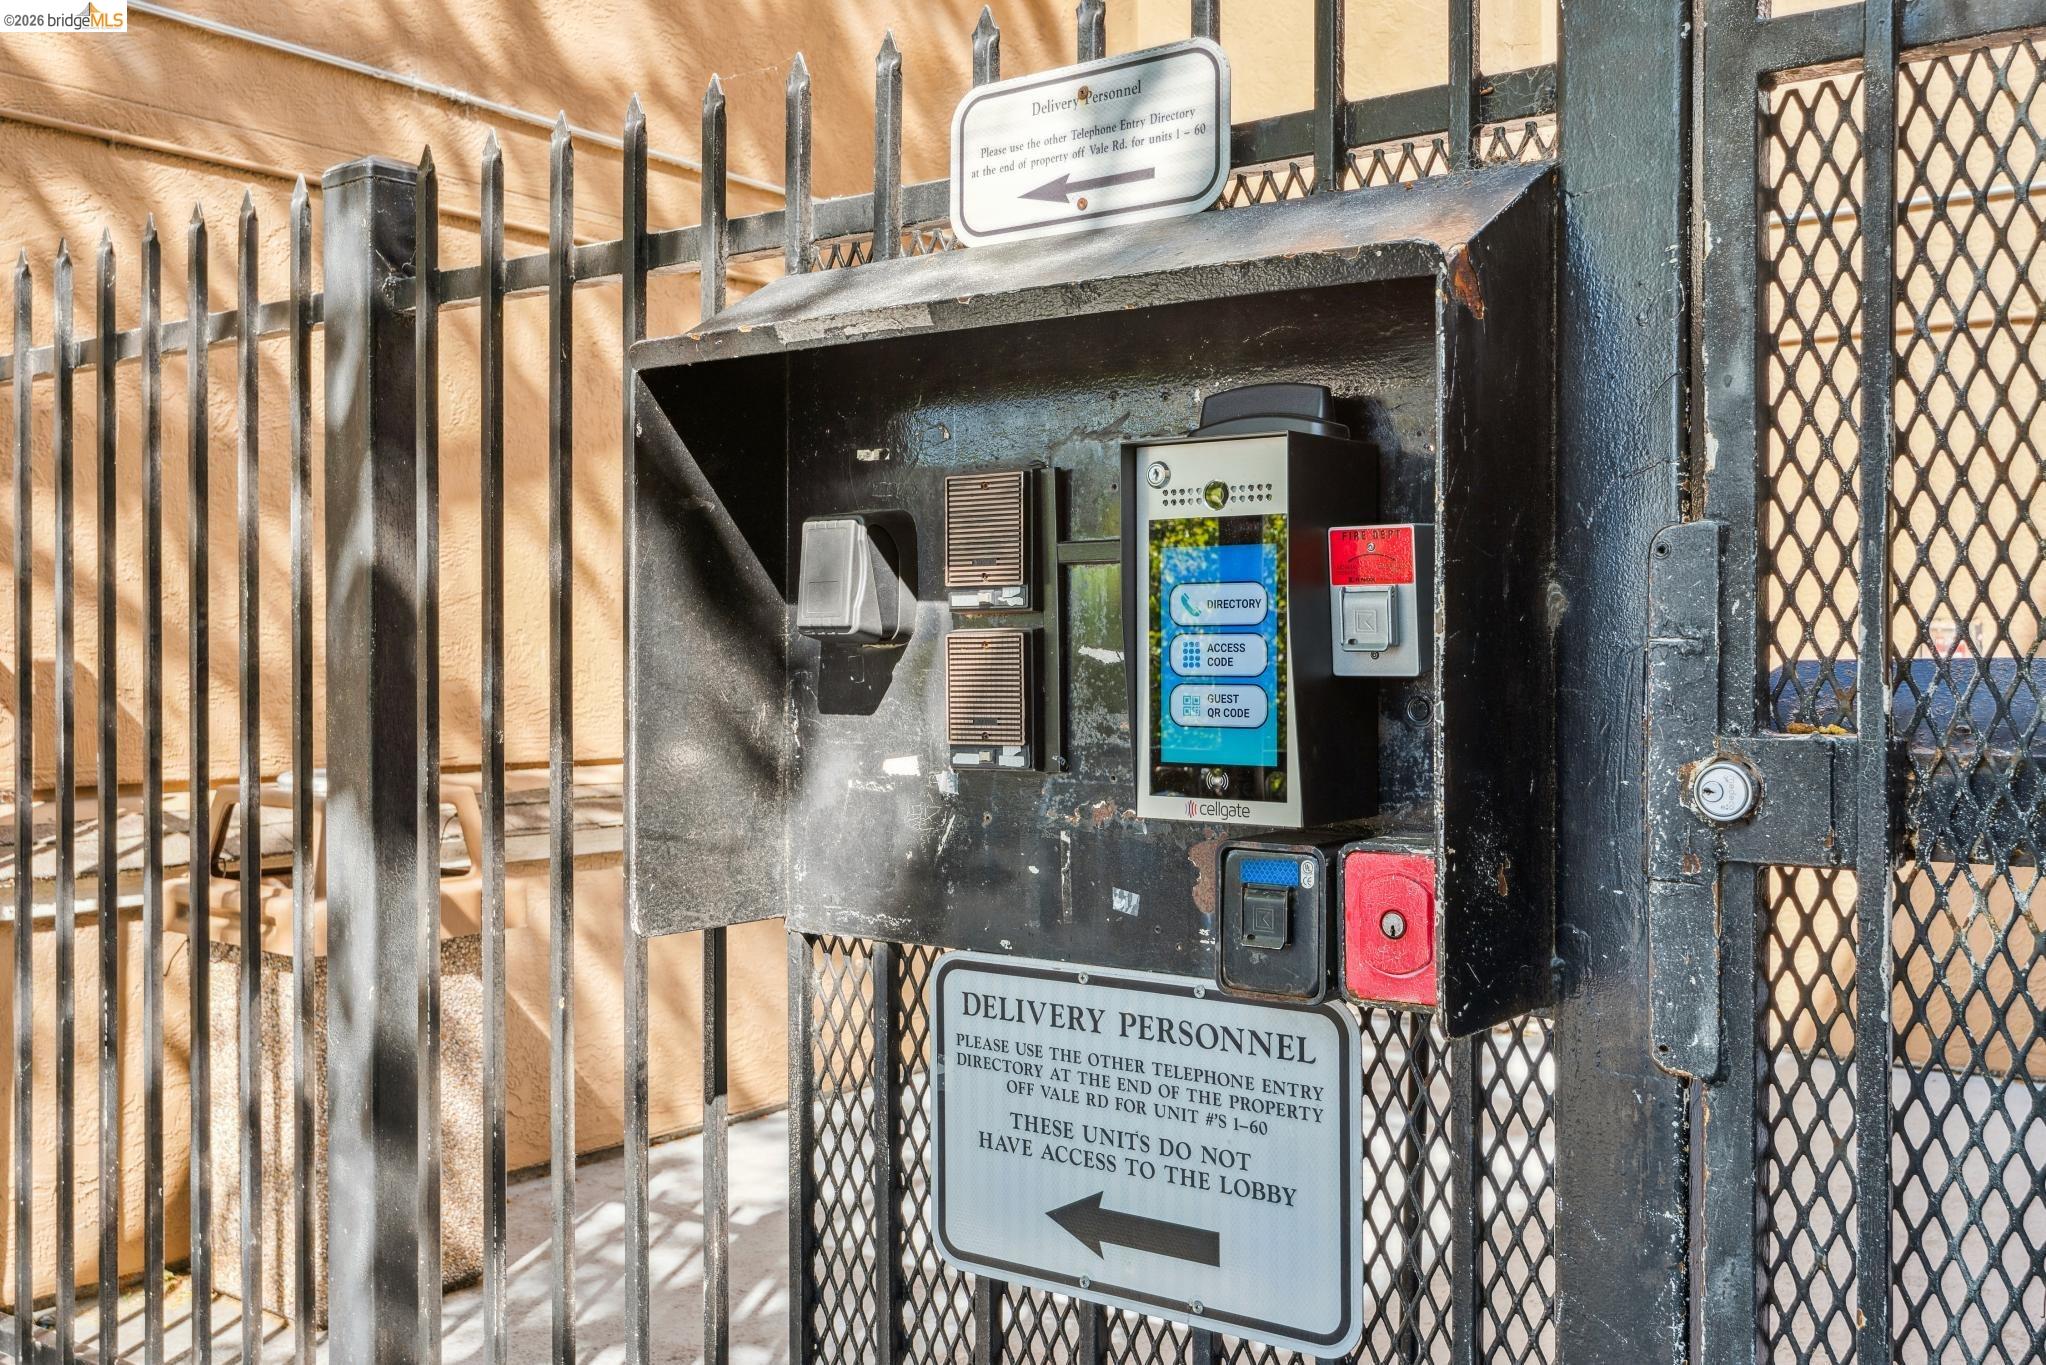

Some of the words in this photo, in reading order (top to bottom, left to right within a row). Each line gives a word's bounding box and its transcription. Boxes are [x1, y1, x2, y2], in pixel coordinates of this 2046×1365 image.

[1032, 98, 1079, 116] Delivery
[1085, 80, 1142, 105] Personnel
[971, 169, 980, 179] at
[982, 165, 996, 176] the
[999, 160, 1015, 173] end
[1018, 158, 1027, 169] of
[1030, 152, 1069, 170] property
[1072, 146, 1086, 159] off
[1089, 143, 1109, 156] Vale
[1112, 138, 1128, 152] Rd.
[1131, 136, 1145, 148] for
[1149, 132, 1173, 145] units
[1194, 123, 1206, 136] 60
[980, 147, 1007, 159] Please
[1010, 143, 1024, 153] use
[1027, 138, 1041, 150] the
[1044, 133, 1067, 146] other
[1071, 124, 1117, 141] Telephone
[1120, 119, 1146, 131] Entry
[1150, 108, 1196, 125] Directory
[1342, 531, 1367, 541] FIRE
[1372, 529, 1402, 540] DEPT
[1207, 599, 1262, 609] DIRECTORY
[1207, 643, 1246, 653] ACCESS
[1207, 657, 1234, 667] CODE
[1207, 694, 1239, 704] GUEST
[1207, 707, 1221, 718] QR
[1223, 708, 1250, 718] CODE
[1200, 801, 1250, 821] cellgate
[962, 991, 1106, 1034] DELIVERY
[1119, 1011, 1317, 1065] PERSONNEL
[956, 1033, 1009, 1054] PLEASE
[1015, 1041, 1043, 1058] USE
[1049, 1046, 1082, 1064] THE
[1087, 1053, 1145, 1074] OTHER
[1152, 1061, 1255, 1091] TELEPHONE
[1262, 1078, 1324, 1101] ENTRY
[957, 1052, 1043, 1078] DIRECTORY
[1050, 1067, 1071, 1082] AT
[1077, 1070, 1111, 1089] THE
[1117, 1077, 1151, 1096] END
[1158, 1083, 1180, 1100] OF
[1186, 1088, 1222, 1107] THE
[1229, 1094, 1324, 1124] PROPERTY
[1006, 1079, 1035, 1096] OFF
[1040, 1085, 1080, 1104] VALE
[1086, 1092, 1109, 1109] RD
[1115, 1097, 1147, 1115] FOR
[1154, 1103, 1199, 1124] UNIT
[1009, 1112, 1074, 1140] THESE
[1082, 1124, 1150, 1153] UNITS
[1159, 1137, 1192, 1160] DO
[1201, 1145, 1252, 1171] NOT
[978, 1131, 1033, 1156] HAVE
[1041, 1144, 1117, 1172] ACCESS
[1125, 1158, 1155, 1179] TO
[1164, 1165, 1211, 1191] THE
[1220, 1175, 1297, 1207] LOBBY
